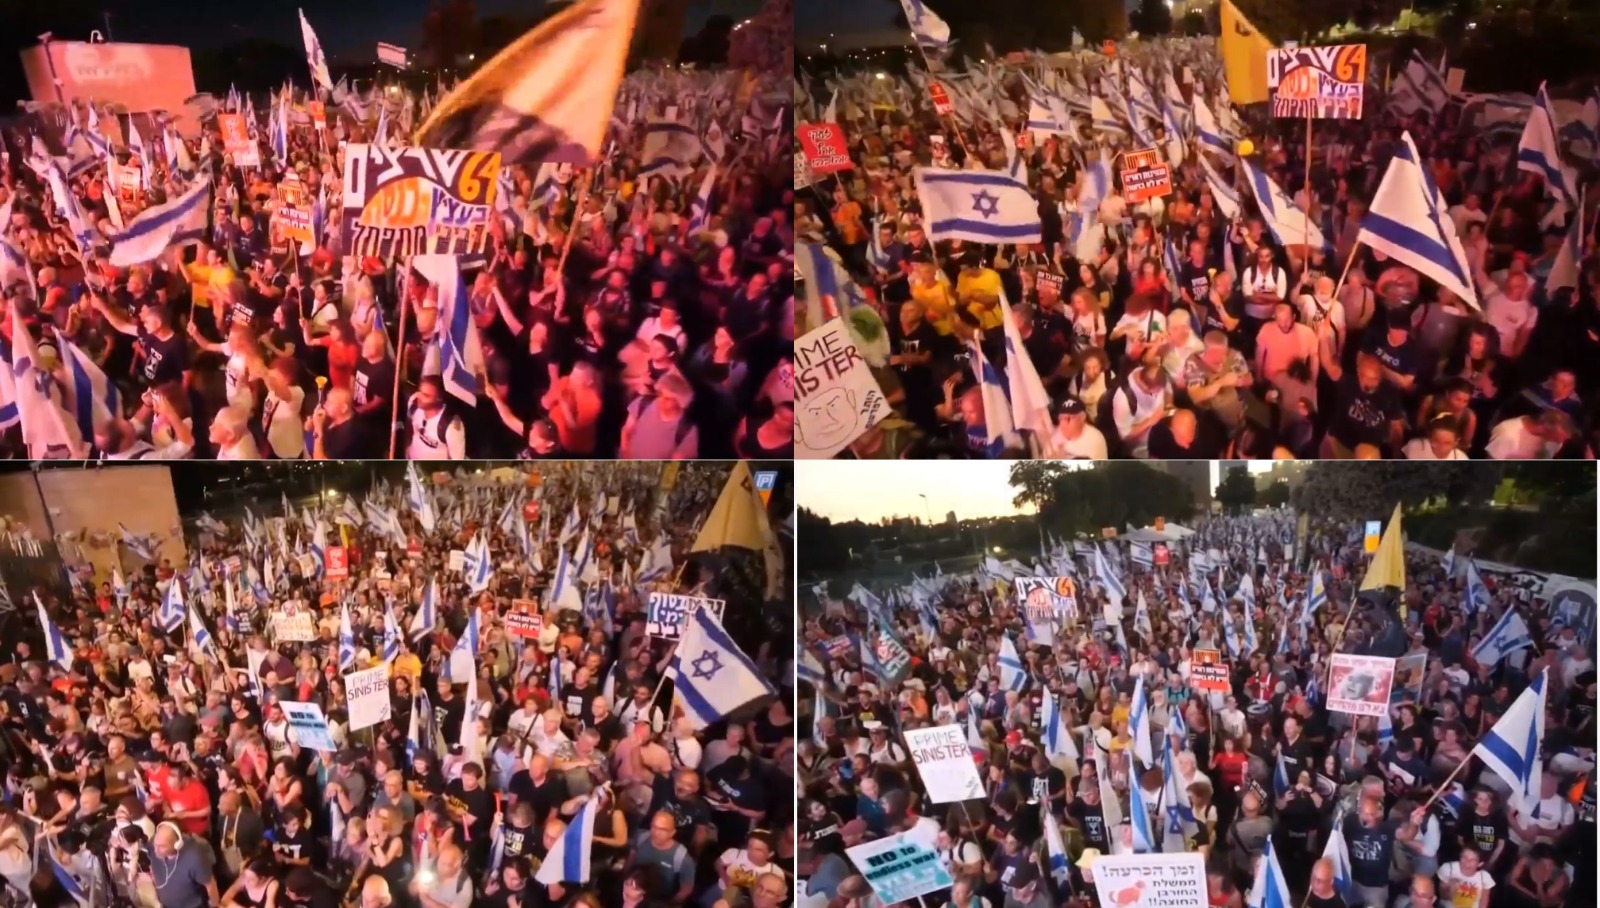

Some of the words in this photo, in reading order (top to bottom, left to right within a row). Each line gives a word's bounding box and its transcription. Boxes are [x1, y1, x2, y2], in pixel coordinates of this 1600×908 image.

[1267, 46, 1340, 88] שרצים
[1336, 44, 1366, 82] 64
[343, 143, 471, 208] שרצים
[459, 151, 501, 204] 64
[348, 679, 389, 700] SINISTER
[913, 743, 971, 765] SINISTER
[866, 851, 897, 867] NO
[900, 846, 916, 856] to
[866, 861, 911, 880] endless
[911, 852, 935, 865] war
[1102, 865, 1163, 877] הכרעה!
[1153, 879, 1196, 887] ממשלת
[1157, 888, 1197, 898] החורבן
